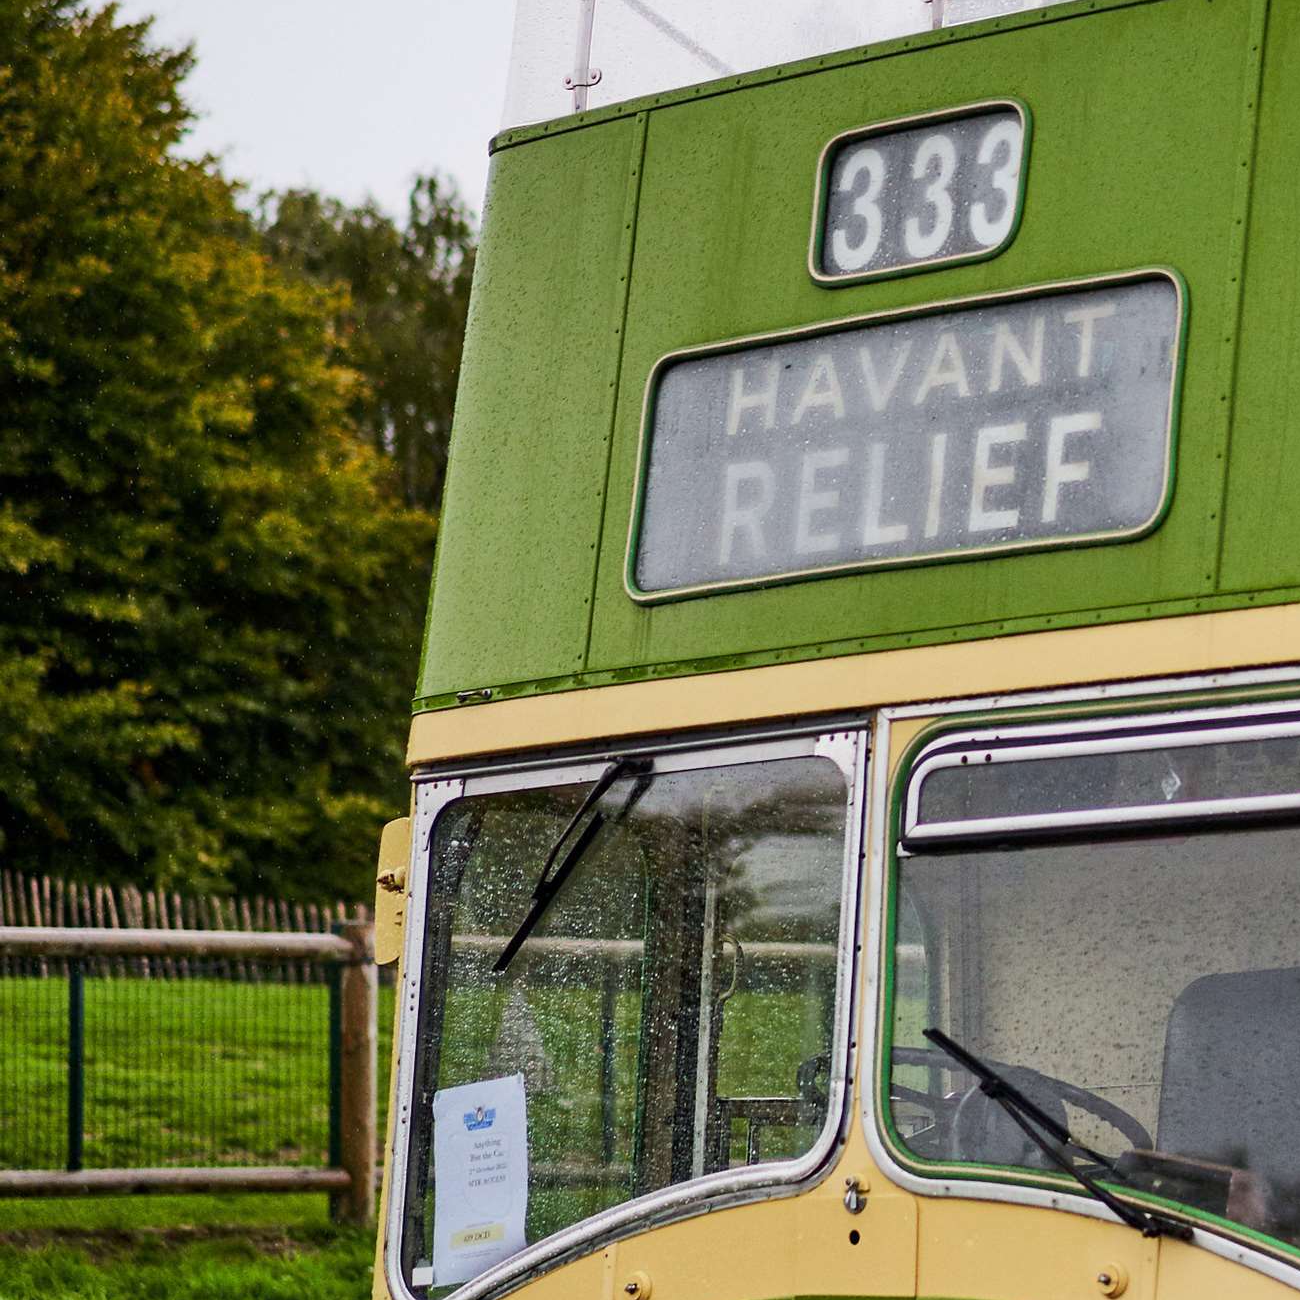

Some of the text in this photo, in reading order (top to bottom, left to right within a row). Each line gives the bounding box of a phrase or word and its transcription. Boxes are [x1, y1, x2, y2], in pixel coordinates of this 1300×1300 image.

[831, 118, 1022, 272] 333
[725, 304, 1116, 436] HAVANT
[718, 410, 1103, 566] RELIEF
